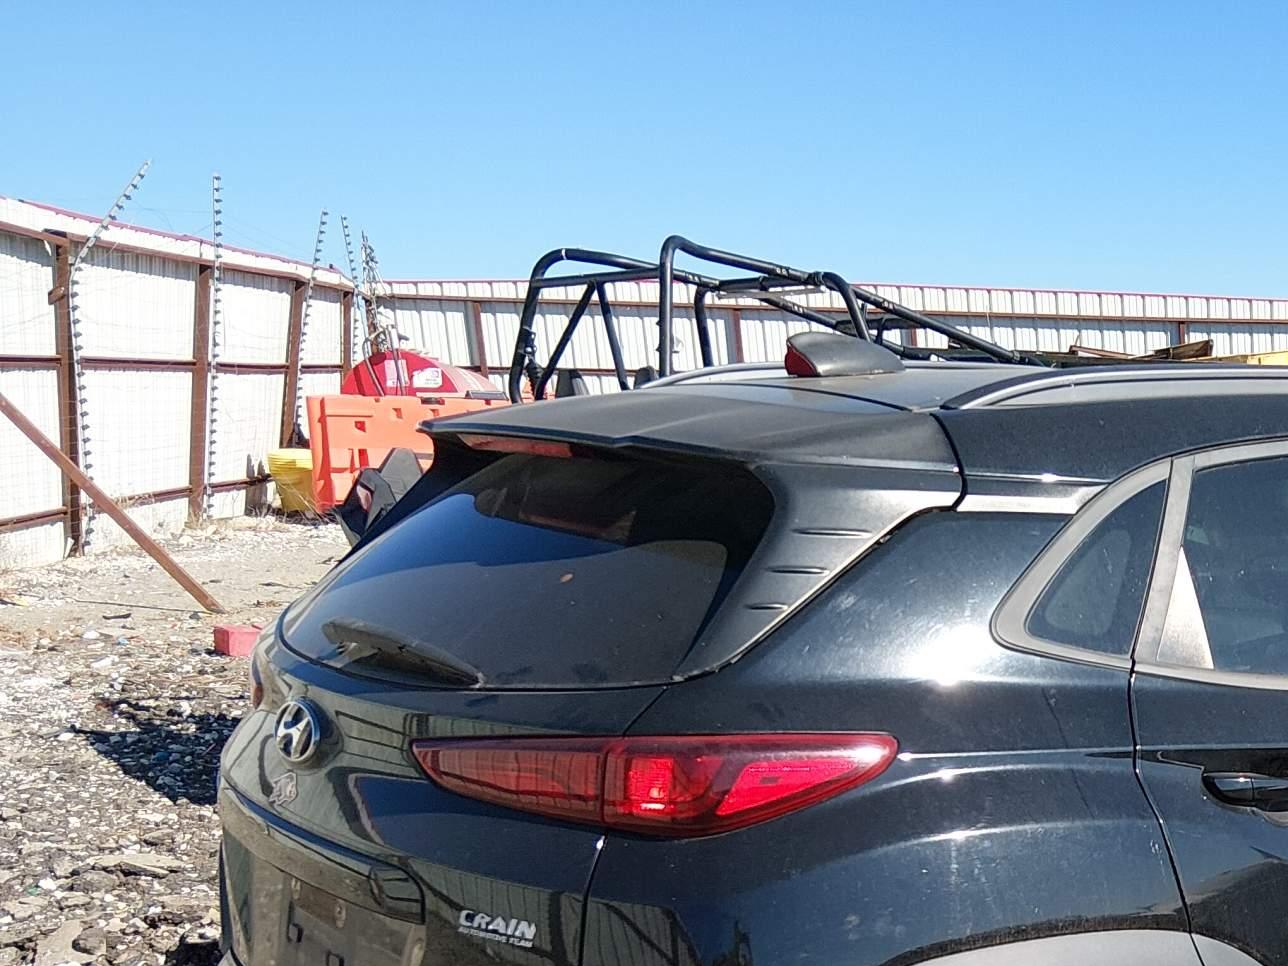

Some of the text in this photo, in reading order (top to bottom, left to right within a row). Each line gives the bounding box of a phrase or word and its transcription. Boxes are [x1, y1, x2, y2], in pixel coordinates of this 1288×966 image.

[458, 909, 537, 940] CRAIN
[458, 926, 534, 948] AUTOMOTIVE TEAM
